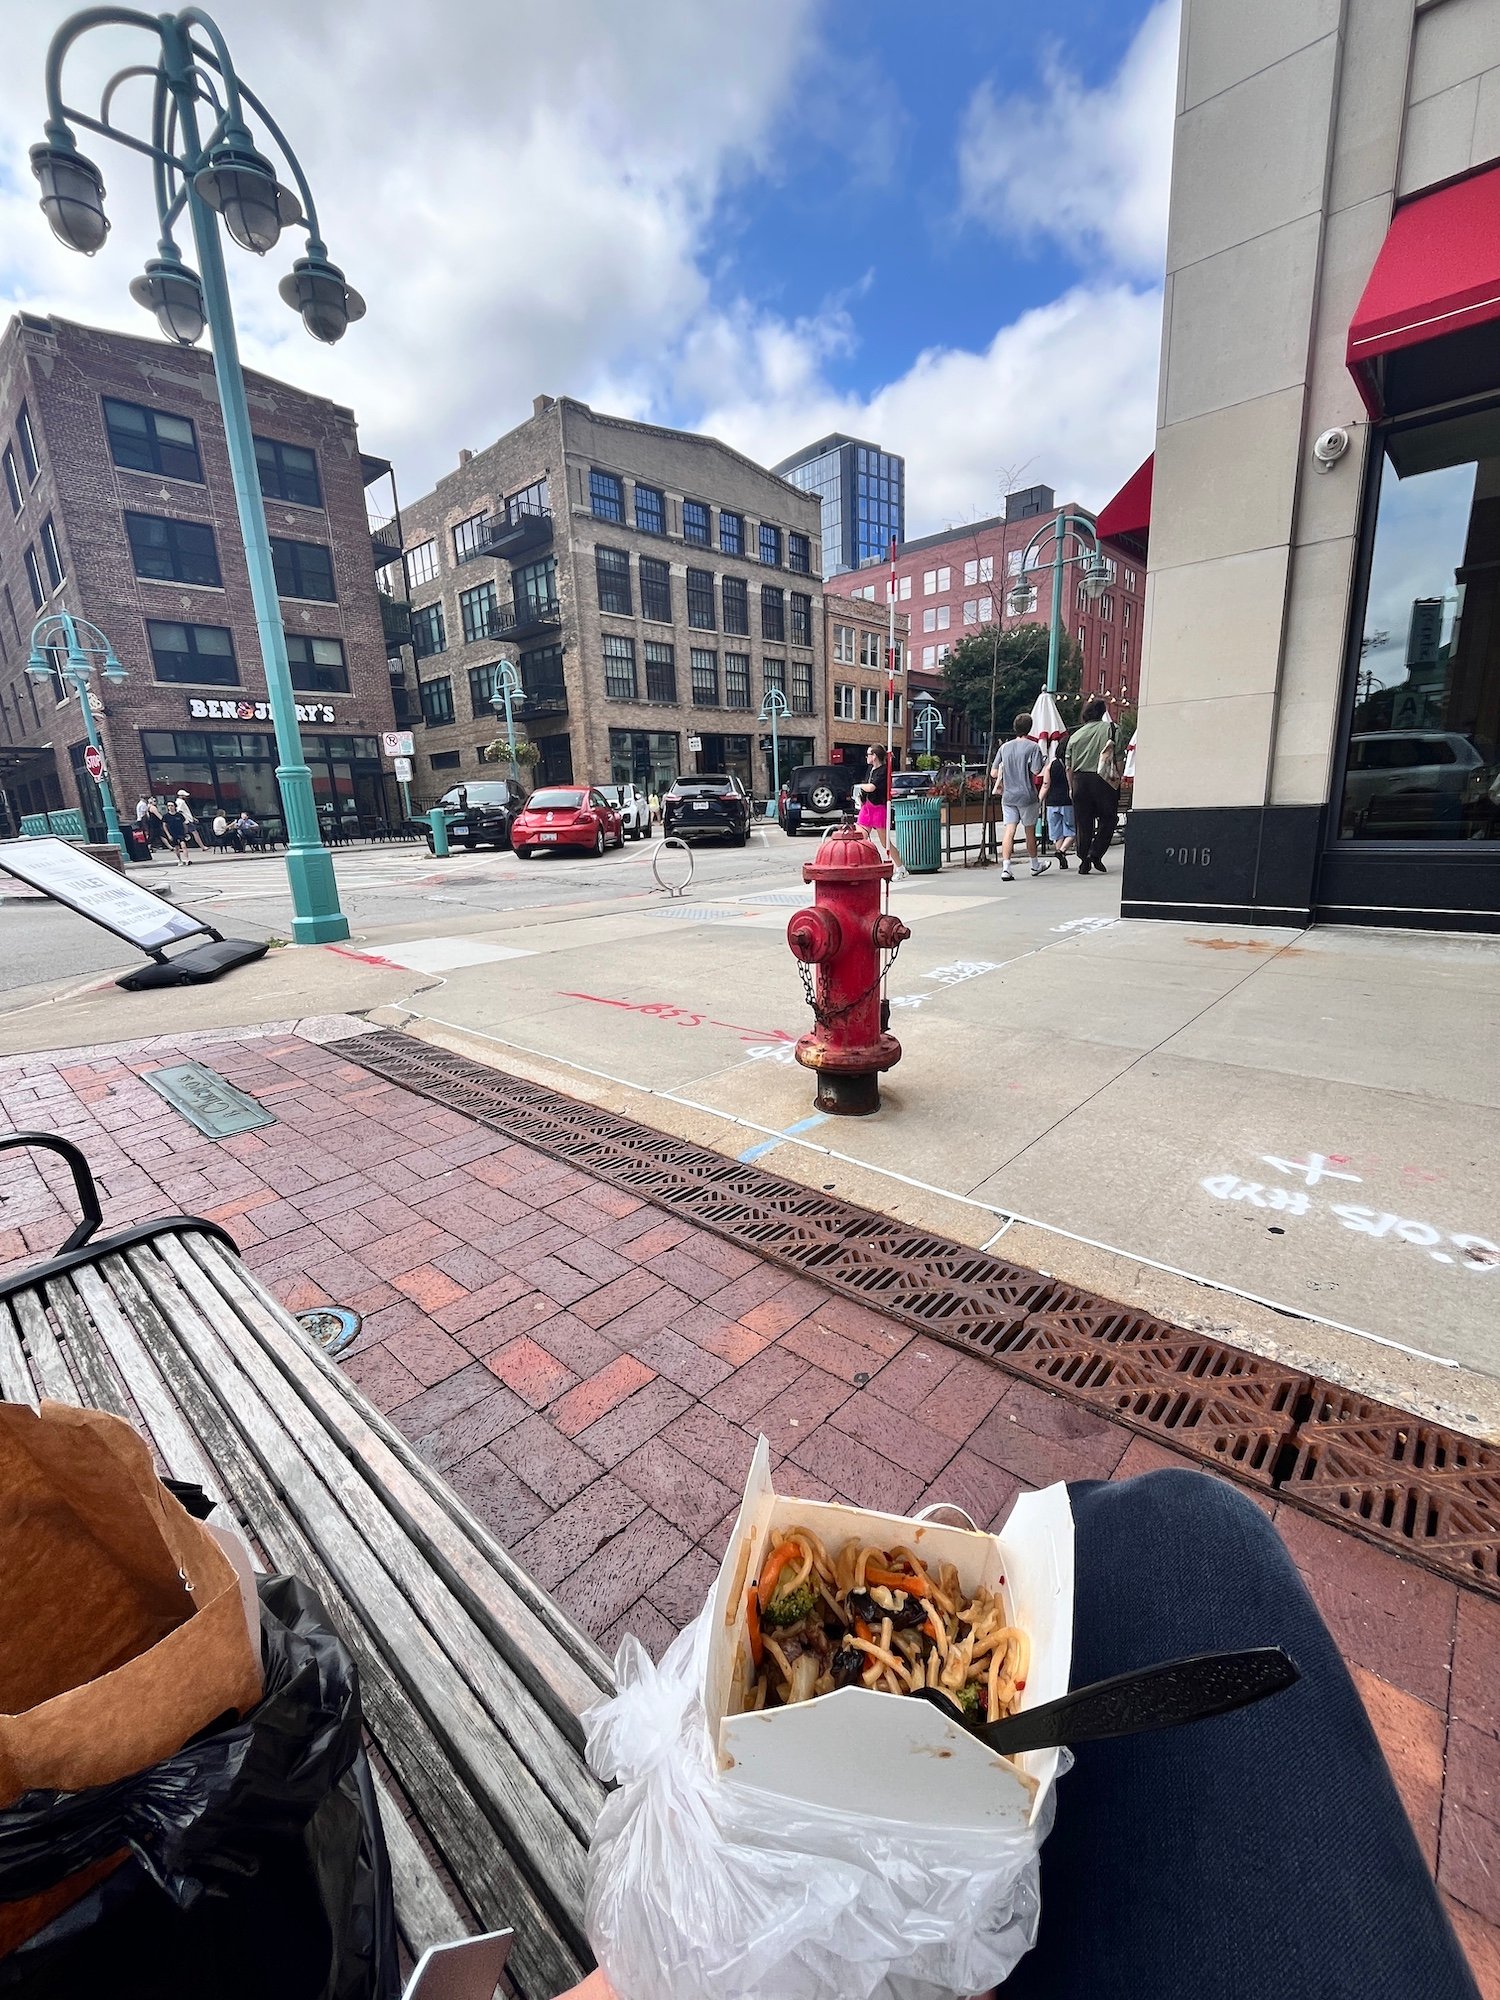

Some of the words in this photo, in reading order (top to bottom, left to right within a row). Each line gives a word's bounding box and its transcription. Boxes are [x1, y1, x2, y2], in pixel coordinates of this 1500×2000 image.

[189, 699, 238, 719] BEN
[254, 702, 335, 723] JRY'S
[1164, 847, 1211, 866] 2016
[65, 877, 109, 891] VALET
[79, 887, 135, 906] PARKING
